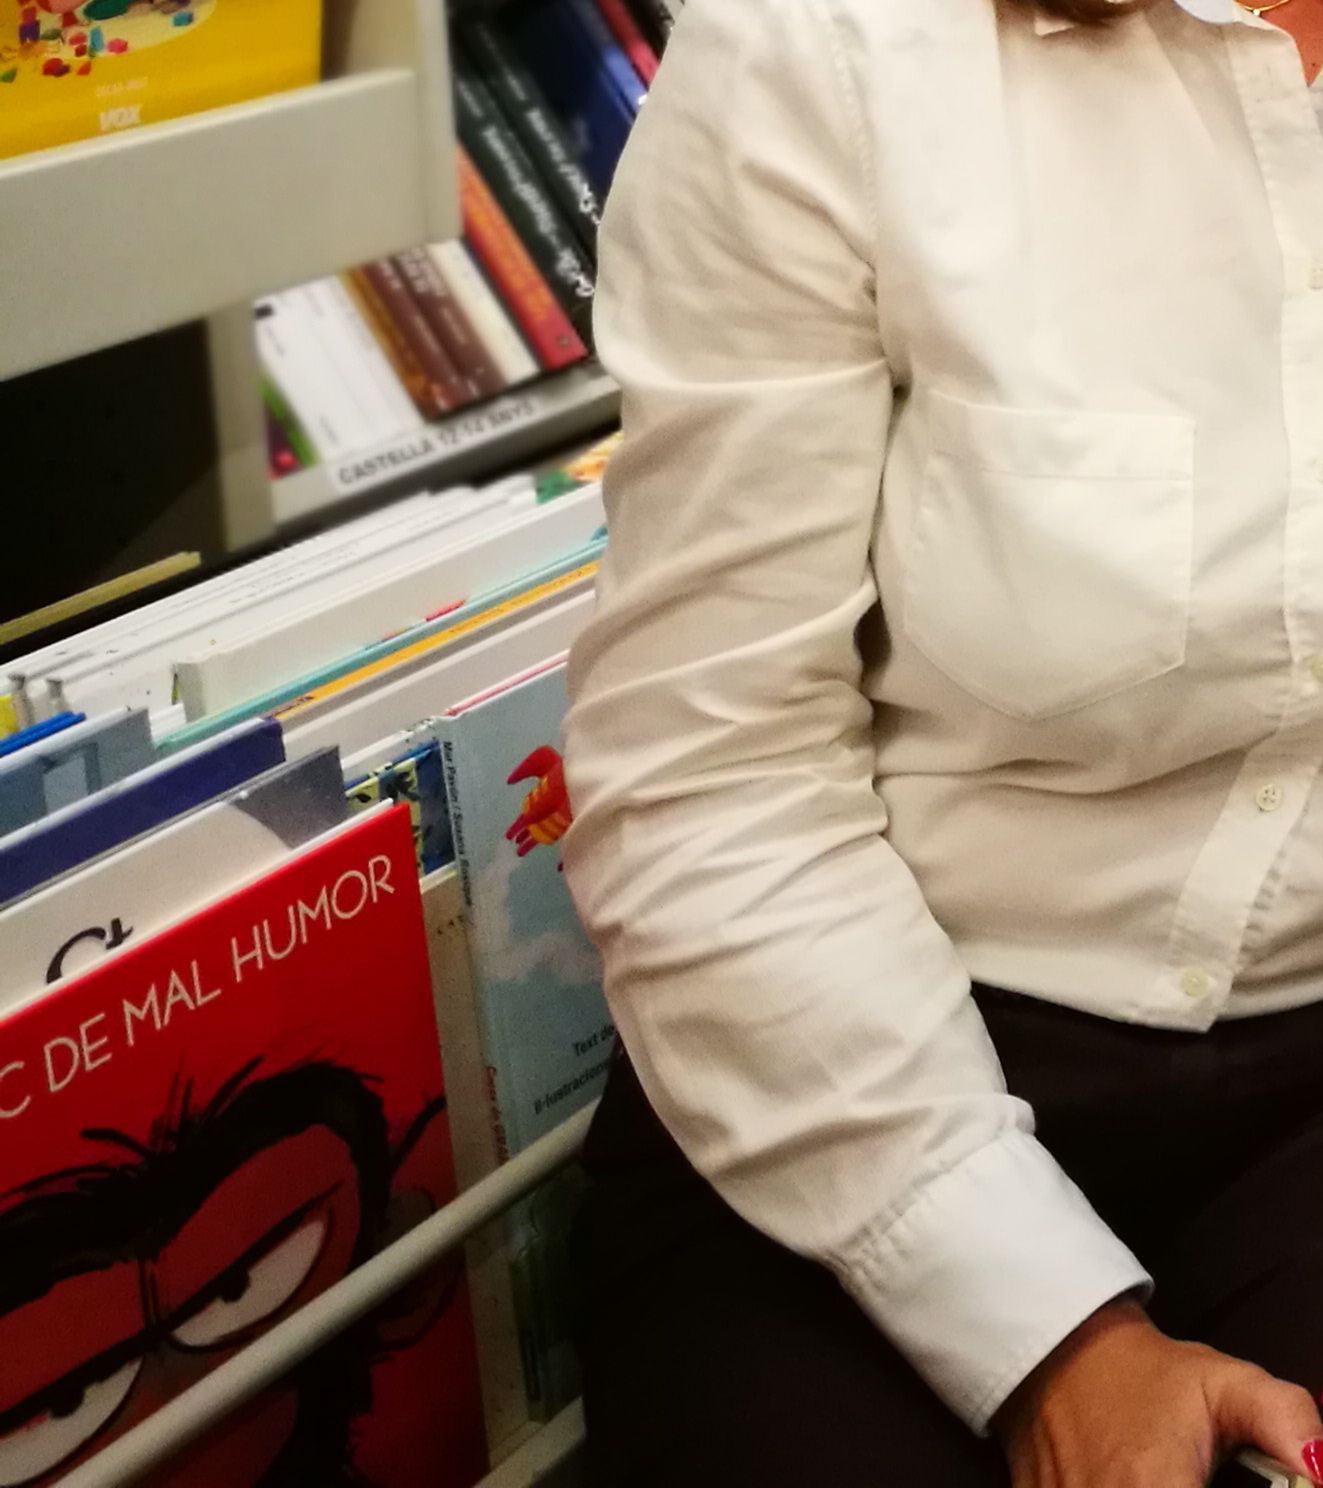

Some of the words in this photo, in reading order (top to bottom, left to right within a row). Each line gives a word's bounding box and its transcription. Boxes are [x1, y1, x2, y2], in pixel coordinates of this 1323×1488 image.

[490, 399, 535, 424] ANYS
[43, 1012, 113, 1094] DE
[122, 959, 222, 1048] MAL
[231, 854, 395, 984] HUMOR
[572, 1032, 599, 1056] Text
